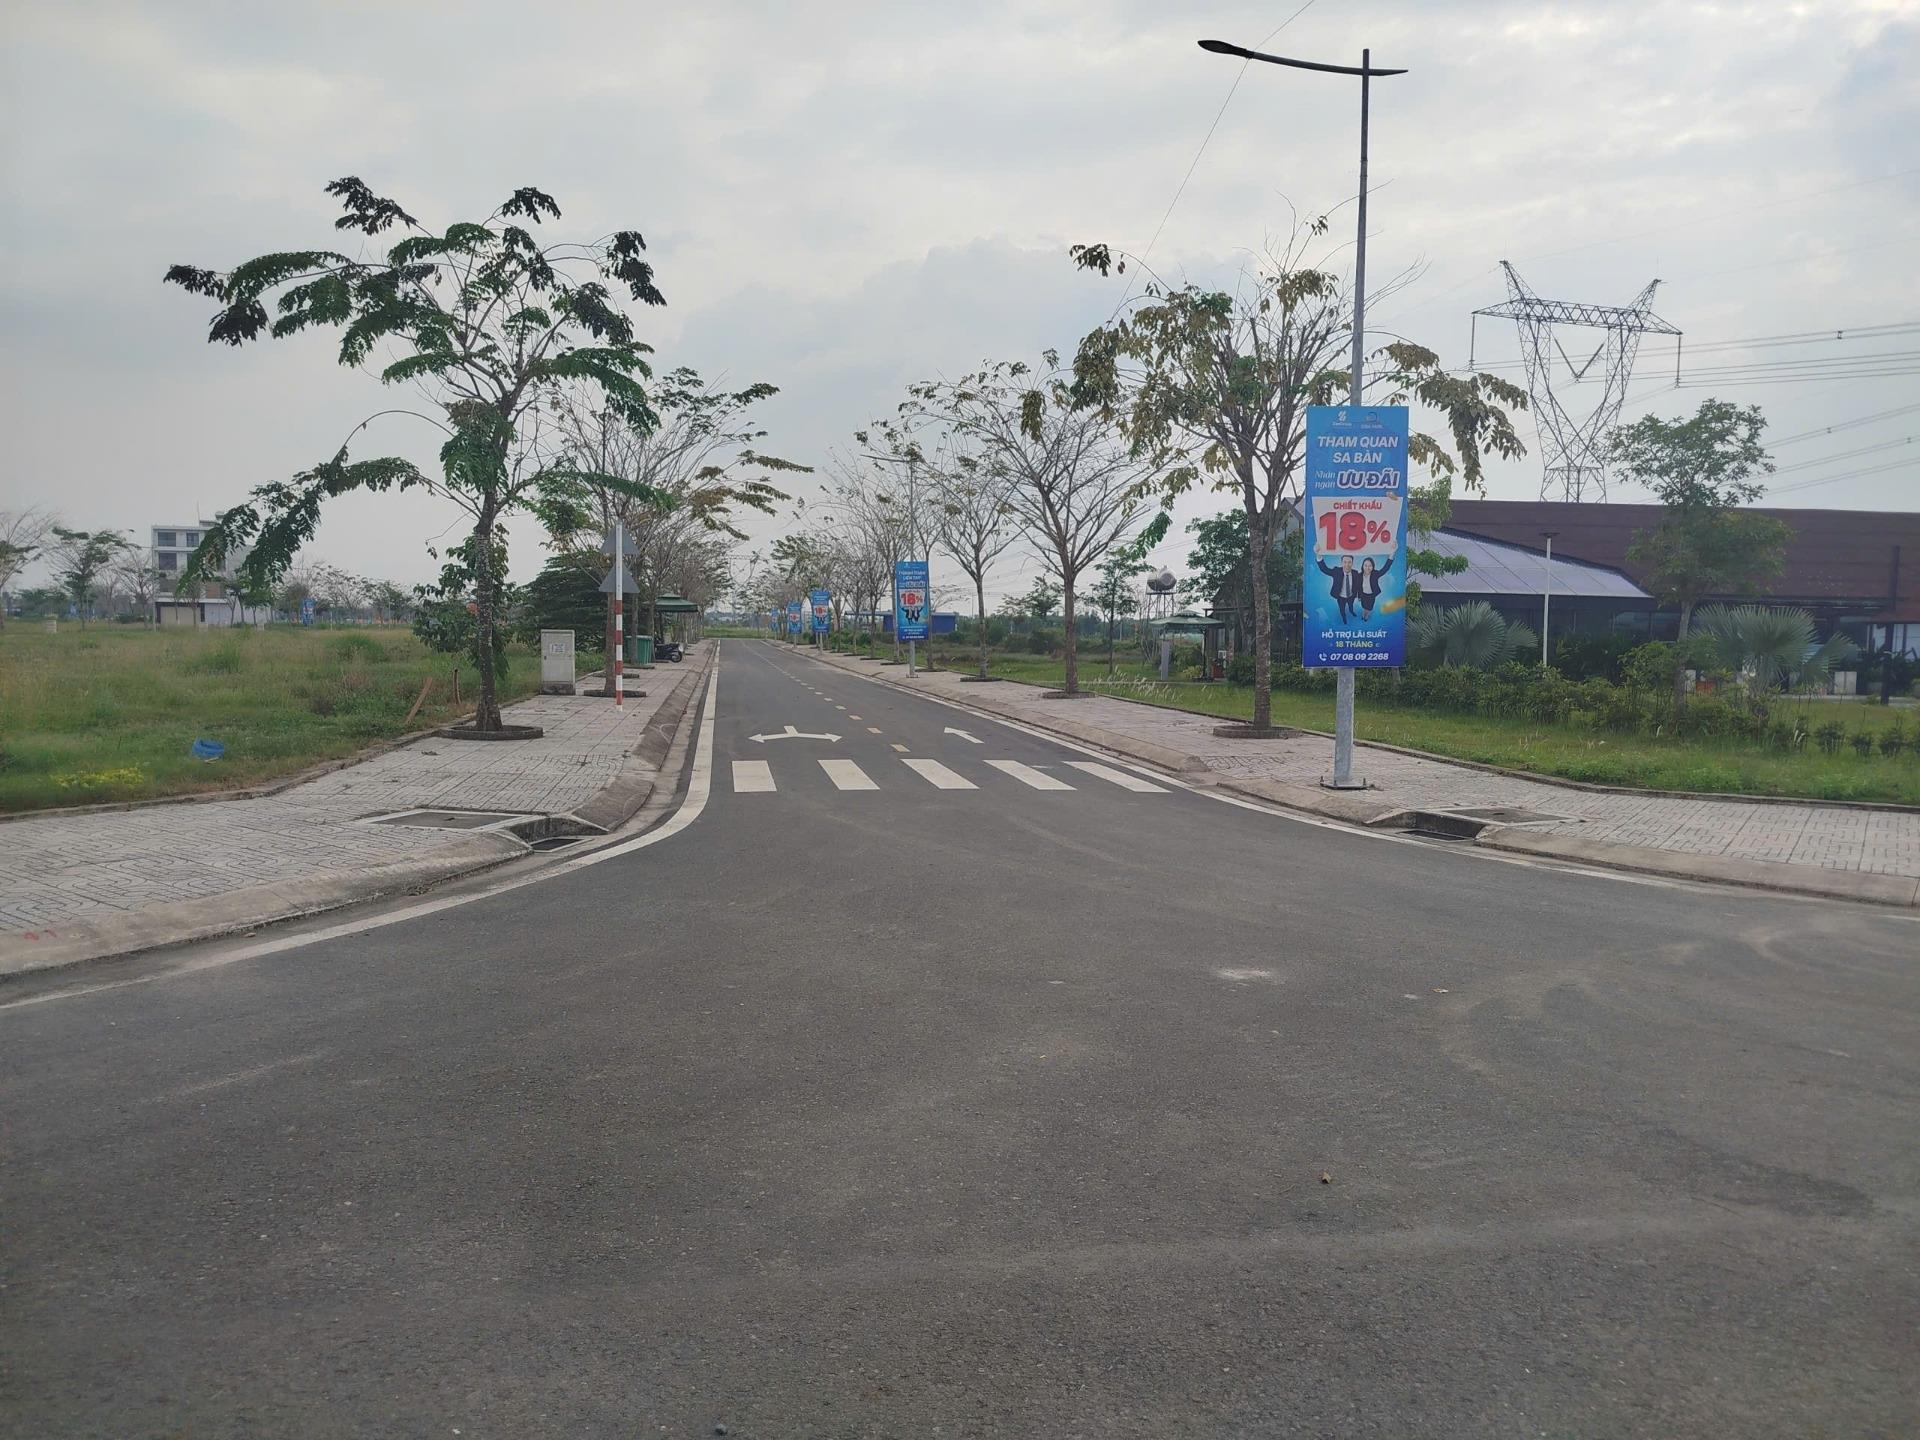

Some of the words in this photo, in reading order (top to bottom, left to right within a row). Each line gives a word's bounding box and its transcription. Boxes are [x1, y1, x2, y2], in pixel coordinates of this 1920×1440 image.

[1318, 436, 1357, 448] THAM
[1359, 436, 1399, 448] QUAN
[1333, 452, 1351, 463] SA
[1353, 449, 1382, 463] BÀN
[1337, 468, 1364, 489] ƯU
[1365, 467, 1400, 489] ĐÃI
[1333, 500, 1358, 510] CHIẾT
[1359, 500, 1382, 509] KHẤU
[1319, 511, 1391, 551] 18%
[1335, 630, 1351, 640] TRỢ
[1366, 628, 1387, 638] SUẤT
[1345, 640, 1373, 648] THÁNG
